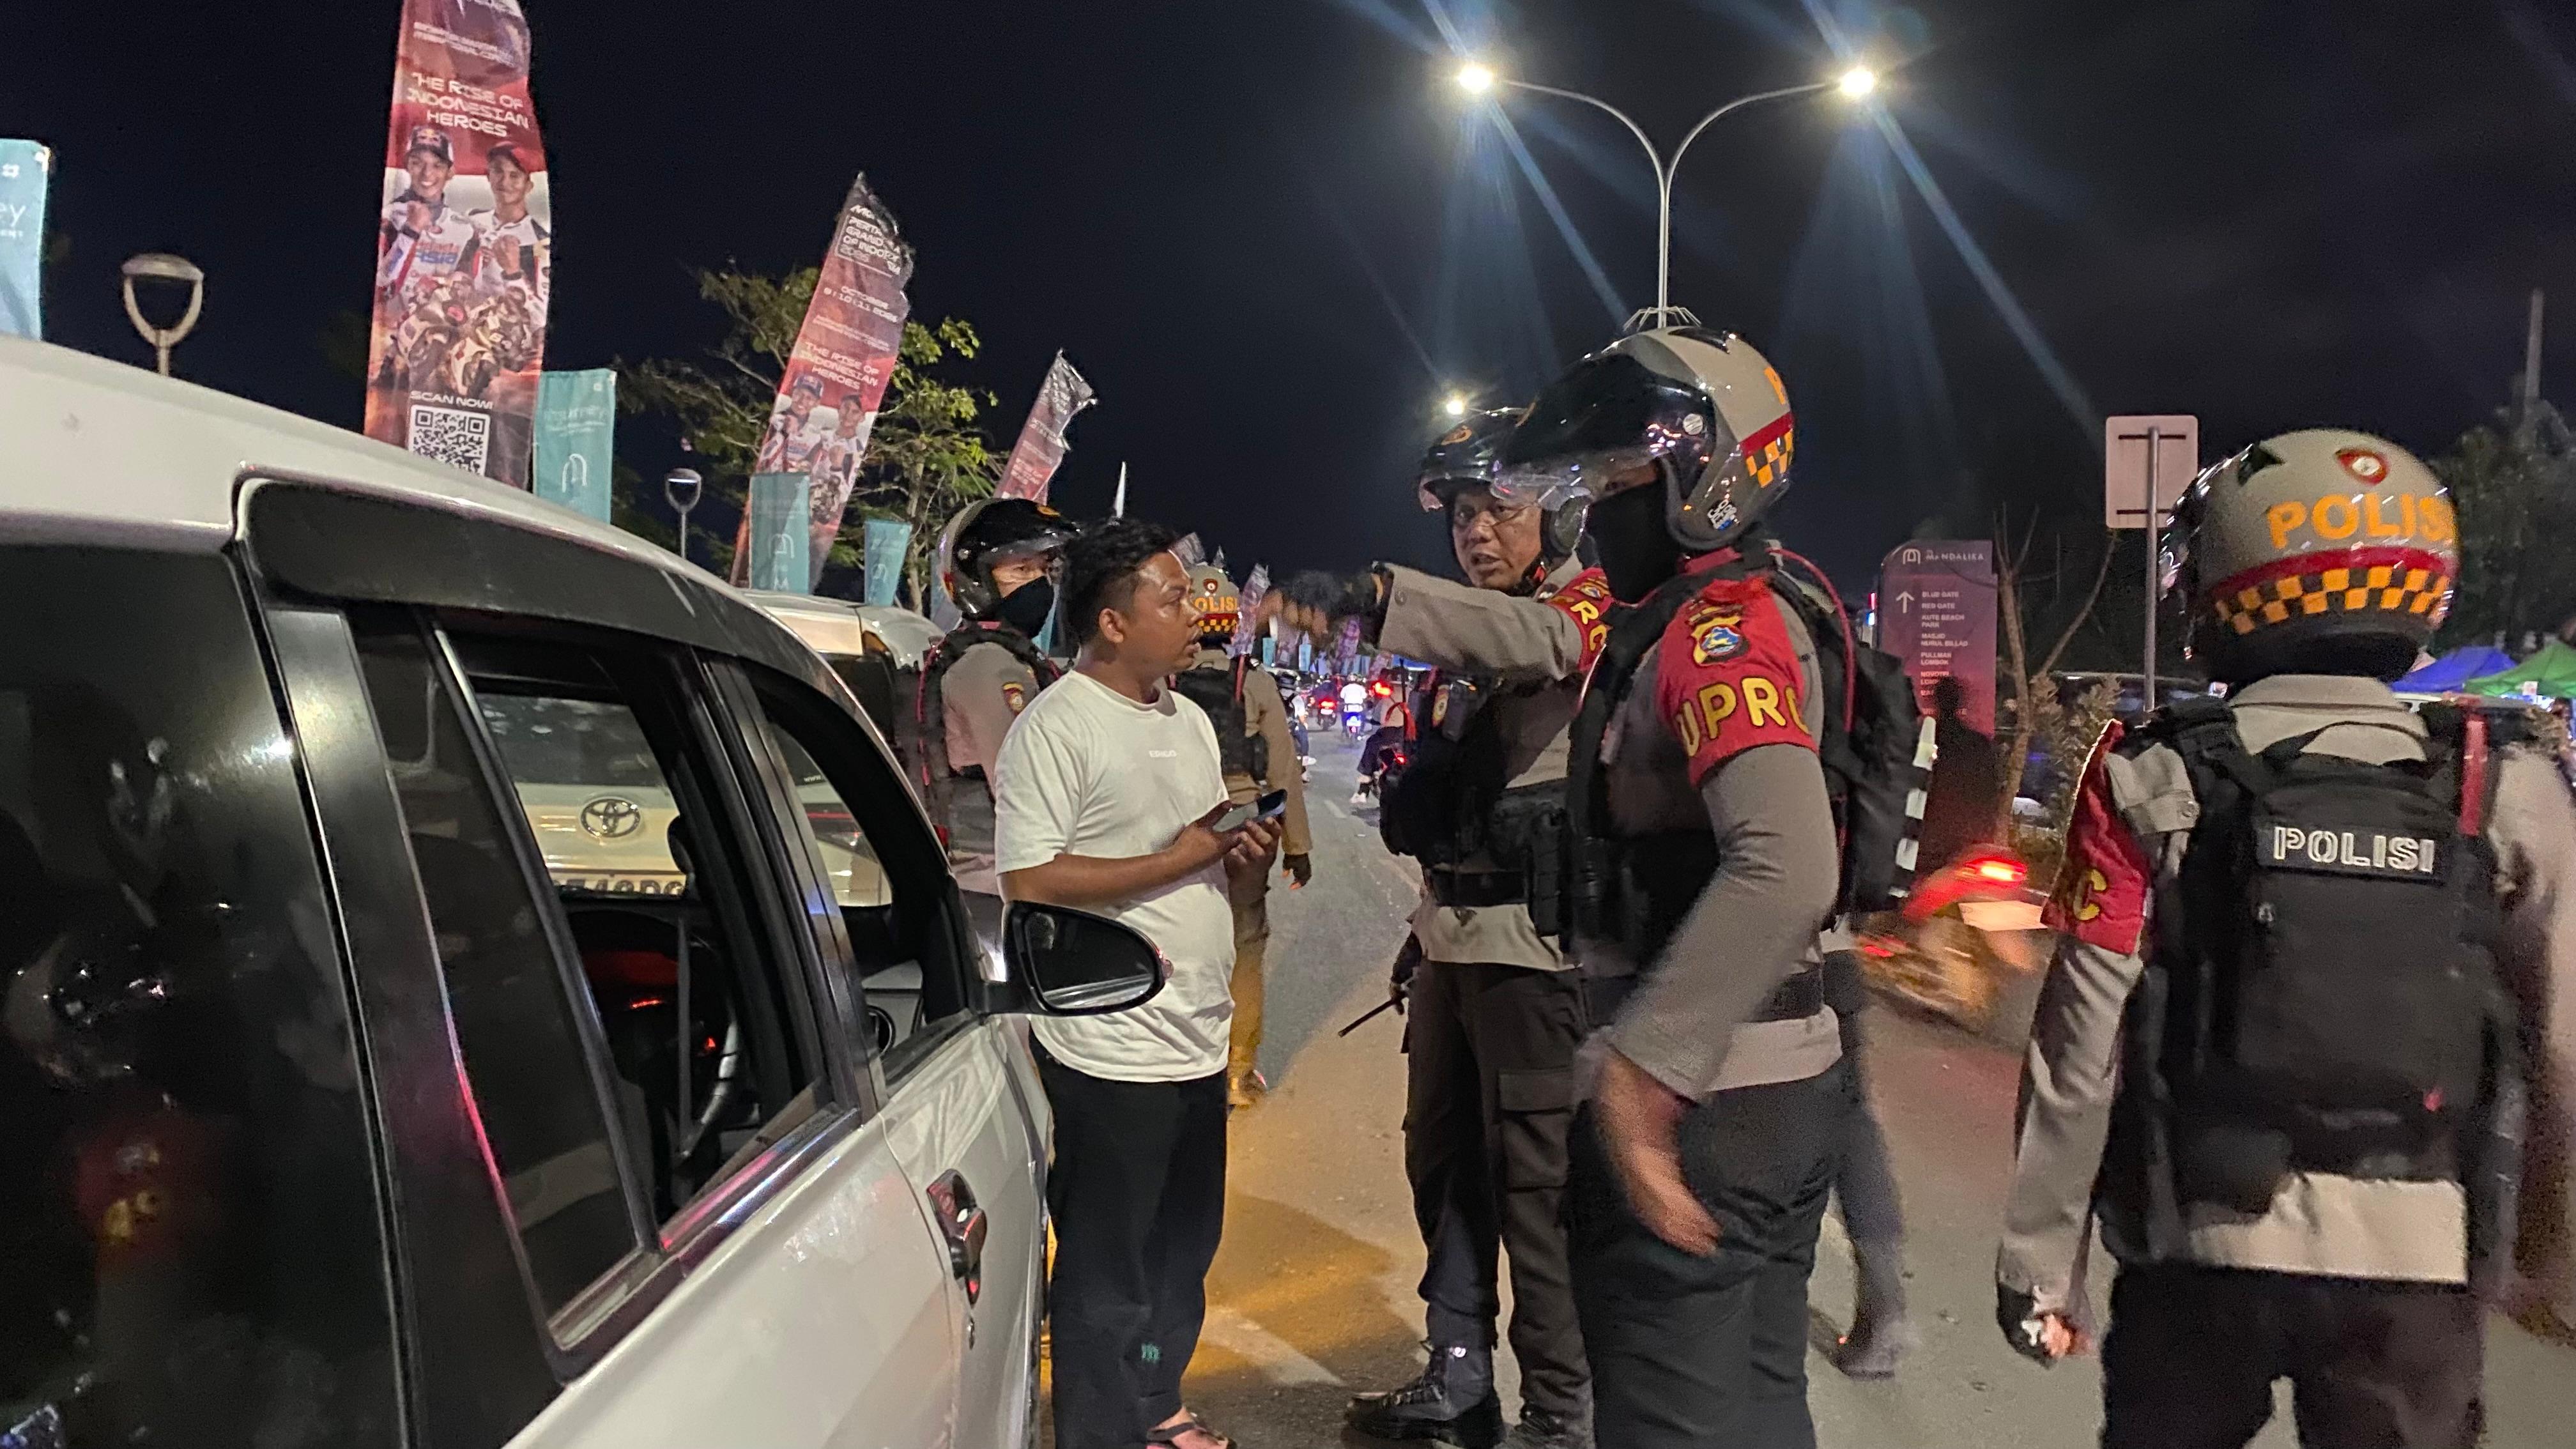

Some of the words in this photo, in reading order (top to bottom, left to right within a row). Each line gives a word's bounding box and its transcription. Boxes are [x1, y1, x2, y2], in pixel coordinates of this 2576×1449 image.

[411, 72, 445, 91] THE
[448, 80, 496, 105] RISE
[499, 95, 523, 110] OF
[407, 87, 529, 128] INDONESIAN
[426, 109, 507, 137] HEROES
[811, 364, 861, 390] HEROES
[863, 365, 880, 374] OF
[410, 390, 454, 404] SCAN
[2266, 493, 2457, 550] POLIS
[1194, 595, 1238, 613] OLISI
[2273, 826, 2435, 873] POLISI
